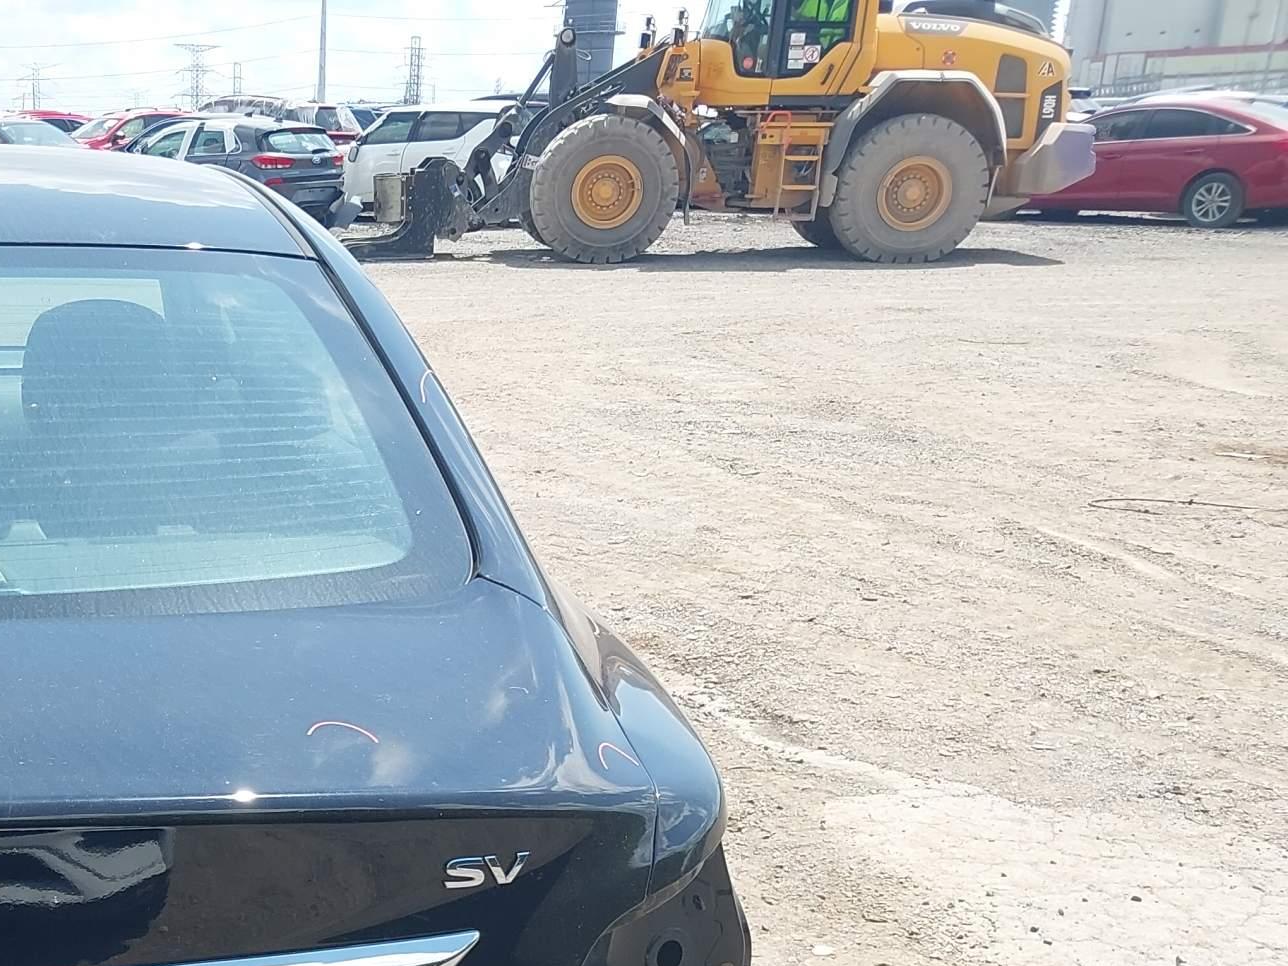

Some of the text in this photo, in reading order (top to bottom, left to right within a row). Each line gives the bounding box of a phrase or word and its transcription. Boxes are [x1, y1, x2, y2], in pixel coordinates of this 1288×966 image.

[909, 21, 961, 32] VOLVO
[1041, 95, 1057, 118] L90H
[443, 851, 530, 888] SV
